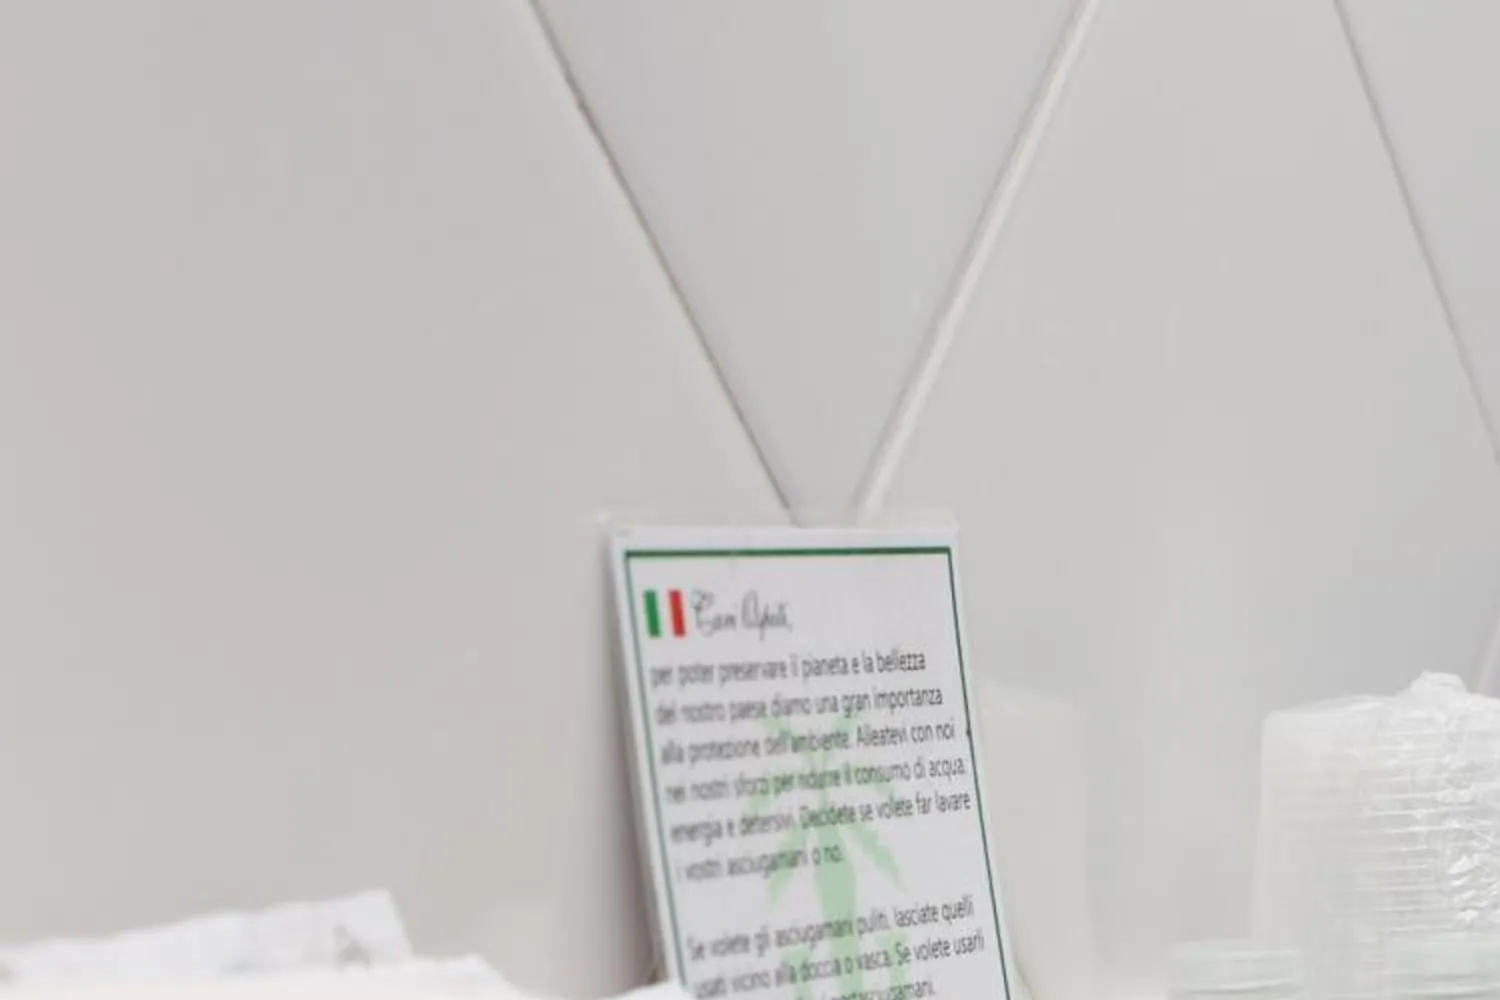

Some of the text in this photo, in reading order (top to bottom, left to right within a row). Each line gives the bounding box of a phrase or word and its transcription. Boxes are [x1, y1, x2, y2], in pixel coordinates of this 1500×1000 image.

[651, 667, 673, 688] per
[679, 663, 714, 687] poter
[719, 660, 788, 687] preservare
[802, 654, 848, 683] pianeta
[852, 657, 860, 674] e
[862, 650, 874, 673] la
[876, 648, 926, 673] bellezza
[681, 702, 726, 725] nostro
[729, 701, 768, 726] paese
[771, 692, 812, 718] diamo
[816, 695, 839, 714] una
[842, 692, 871, 719] gran
[872, 685, 943, 716] importanza
[688, 736, 761, 768] protezione
[857, 722, 908, 748] Alleatevi
[911, 724, 932, 744] con
[936, 717, 956, 740] noi
[774, 774, 794, 798] per
[855, 763, 911, 785] consumo
[914, 756, 926, 779] di
[670, 815, 723, 848] energia
[727, 818, 735, 838] e
[800, 803, 856, 830] Decidete
[859, 803, 874, 822] se
[877, 793, 914, 820] volete
[916, 790, 931, 815] far
[935, 790, 971, 814] lavare
[728, 848, 808, 880] asciugamani
[812, 848, 821, 866] o
[710, 932, 751, 958] volete
[754, 924, 770, 959] gli
[775, 919, 853, 950] asciugamani
[894, 902, 938, 929] lasciate
[942, 894, 975, 925] quelli
[731, 967, 771, 993] vicino
[775, 961, 798, 988] alla
[801, 957, 842, 983] doccia
[845, 956, 853, 975] o
[895, 941, 911, 966] Se
[914, 936, 950, 961] volete
[953, 927, 985, 956] usarli
